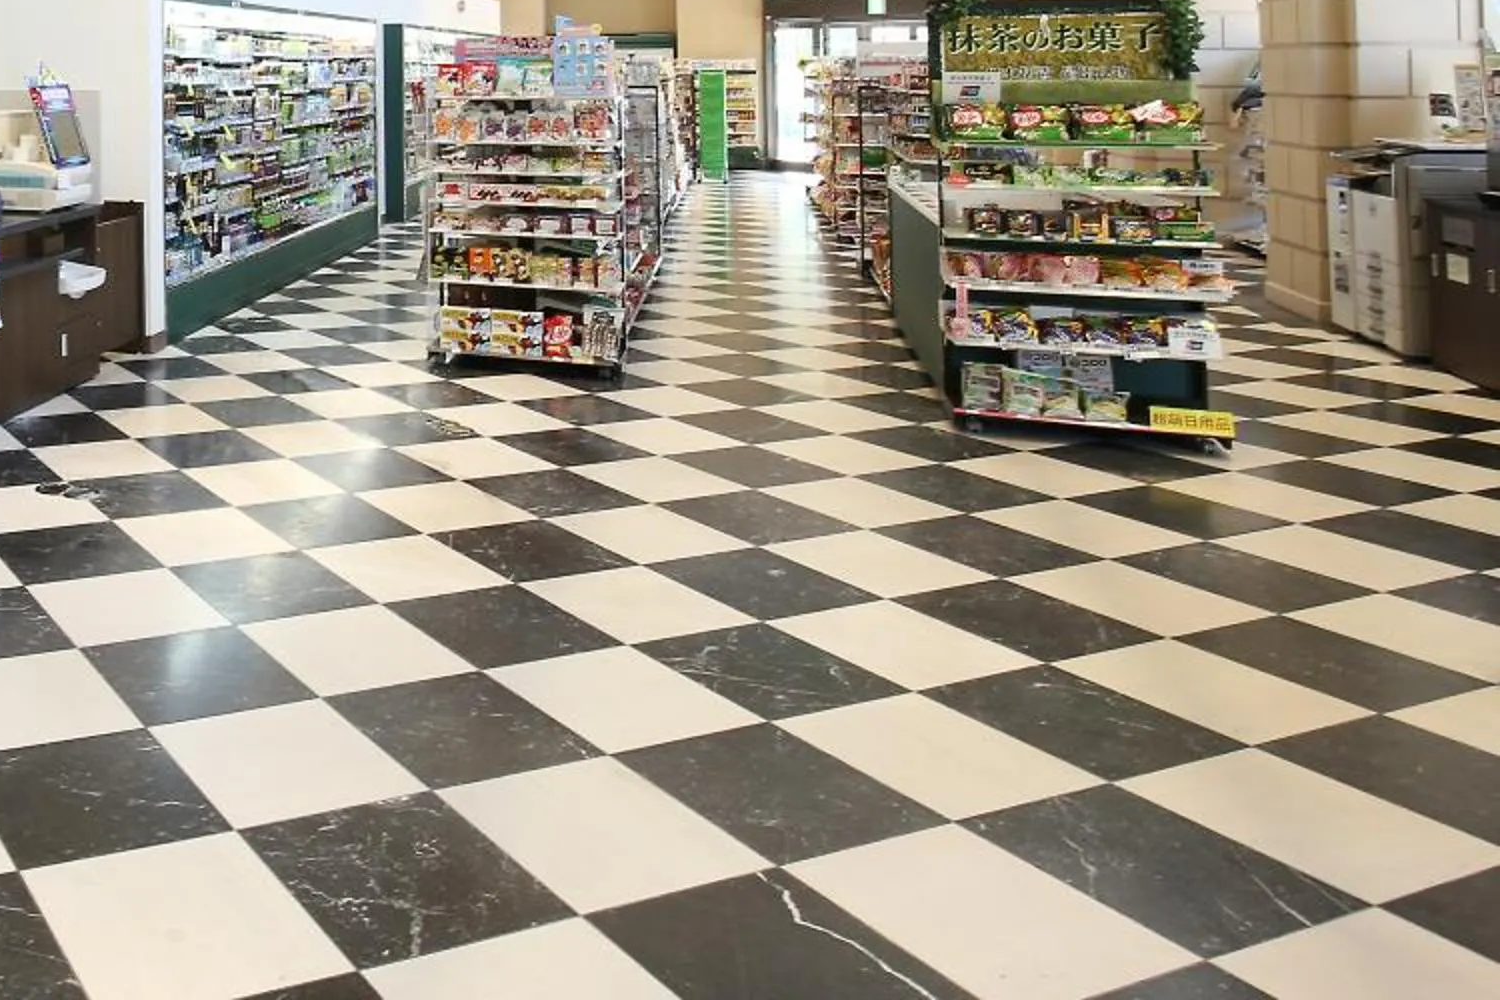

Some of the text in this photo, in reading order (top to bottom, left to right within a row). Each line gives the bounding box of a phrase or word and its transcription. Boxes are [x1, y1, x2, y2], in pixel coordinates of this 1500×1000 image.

[948, 22, 1163, 54] 抹茶のお菓子
